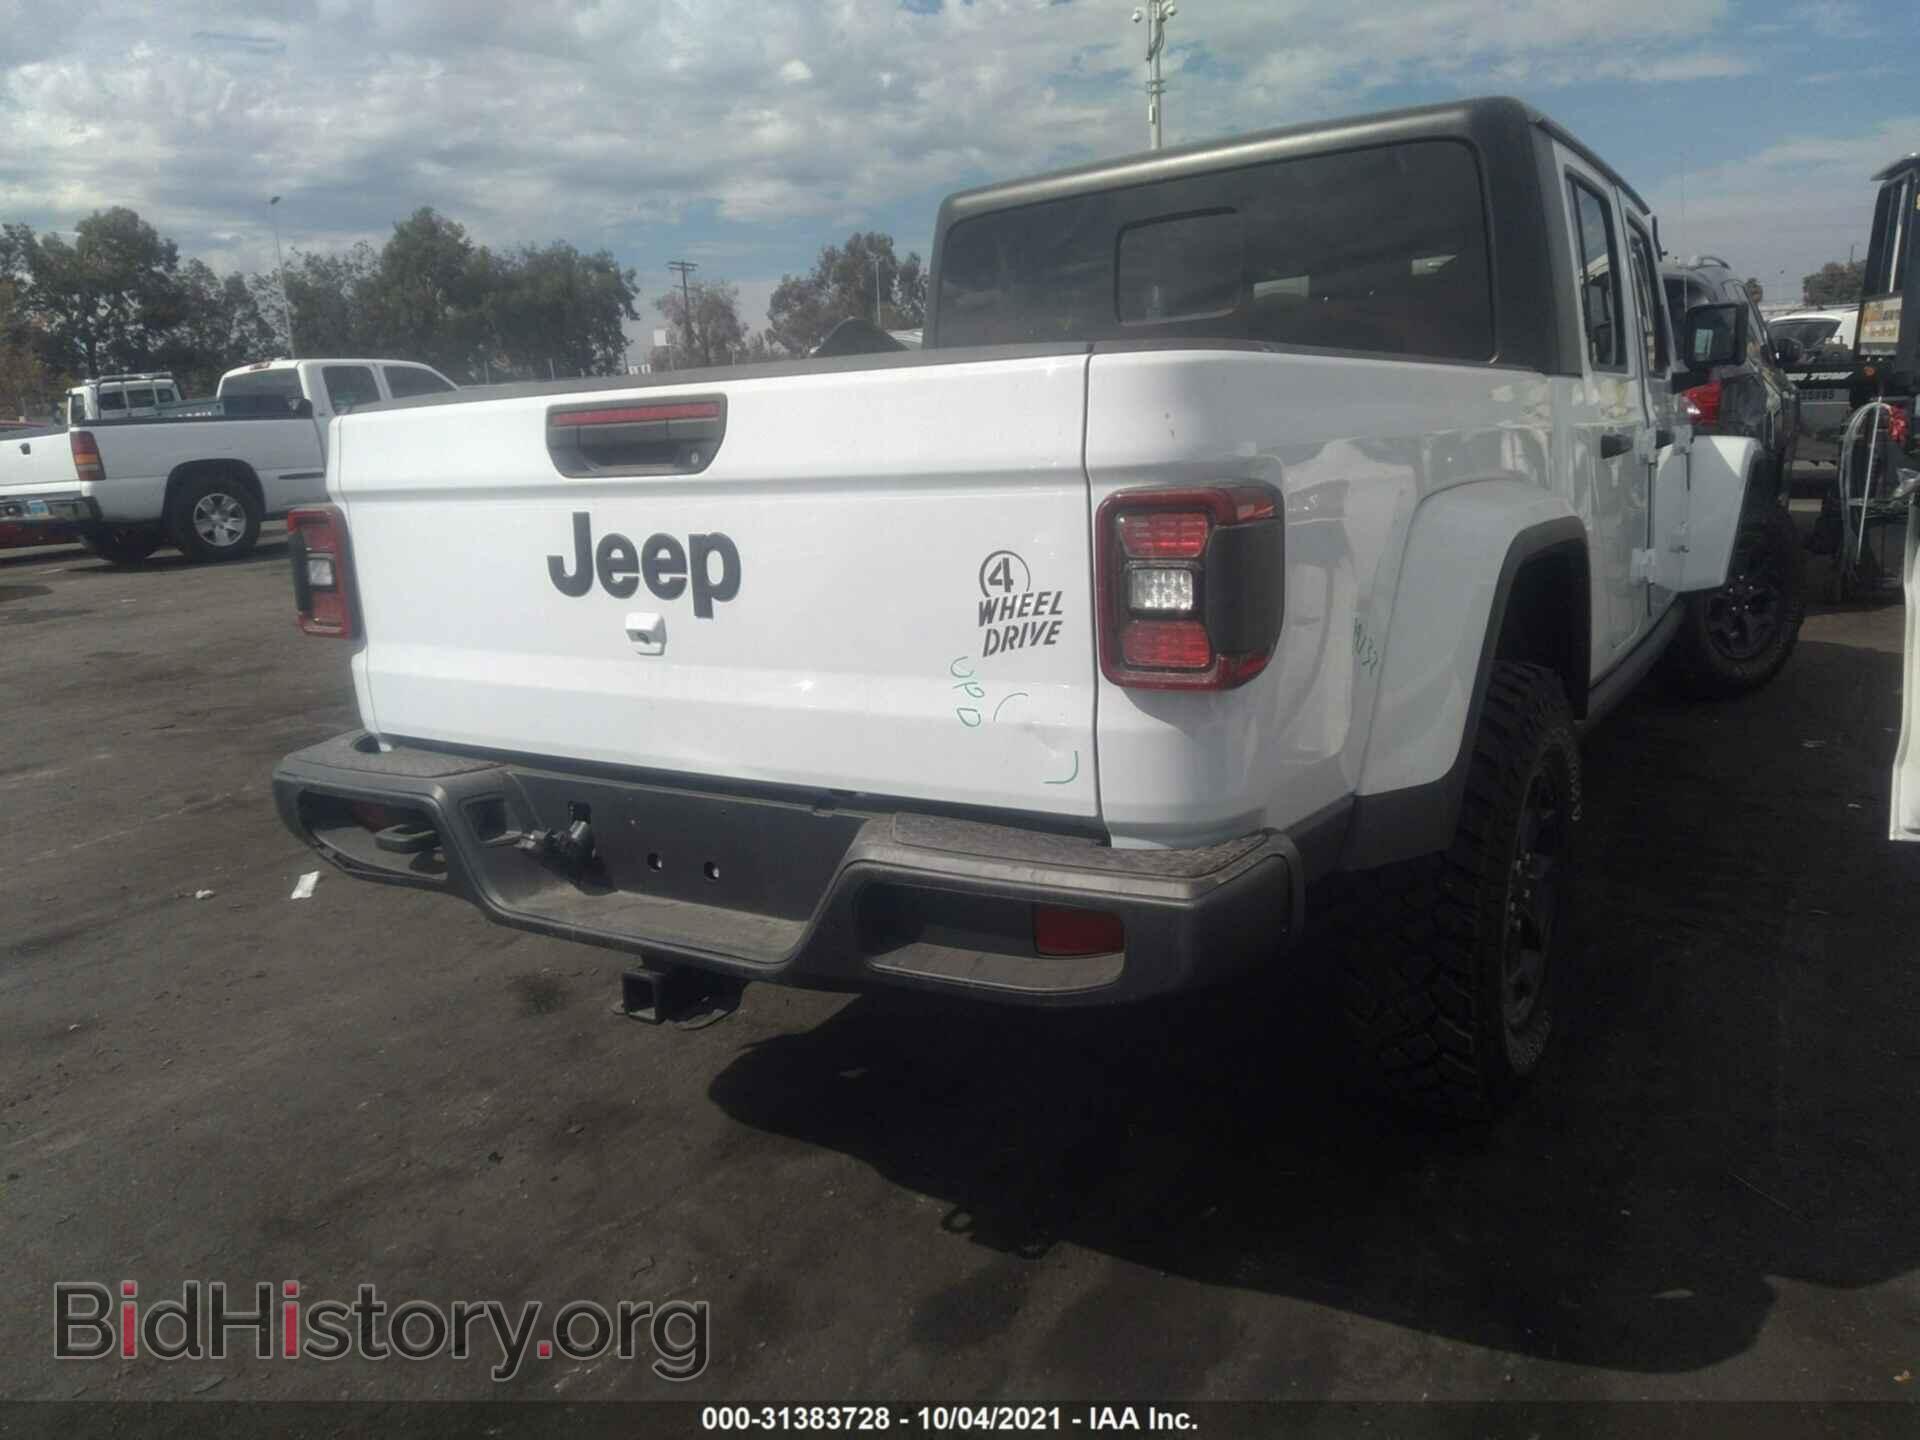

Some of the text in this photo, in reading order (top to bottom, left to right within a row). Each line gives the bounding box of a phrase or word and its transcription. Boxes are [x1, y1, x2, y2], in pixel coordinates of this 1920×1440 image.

[547, 512, 741, 619] Jeep
[978, 591, 1063, 627] WHEEL
[983, 620, 1063, 658] DRIVE
